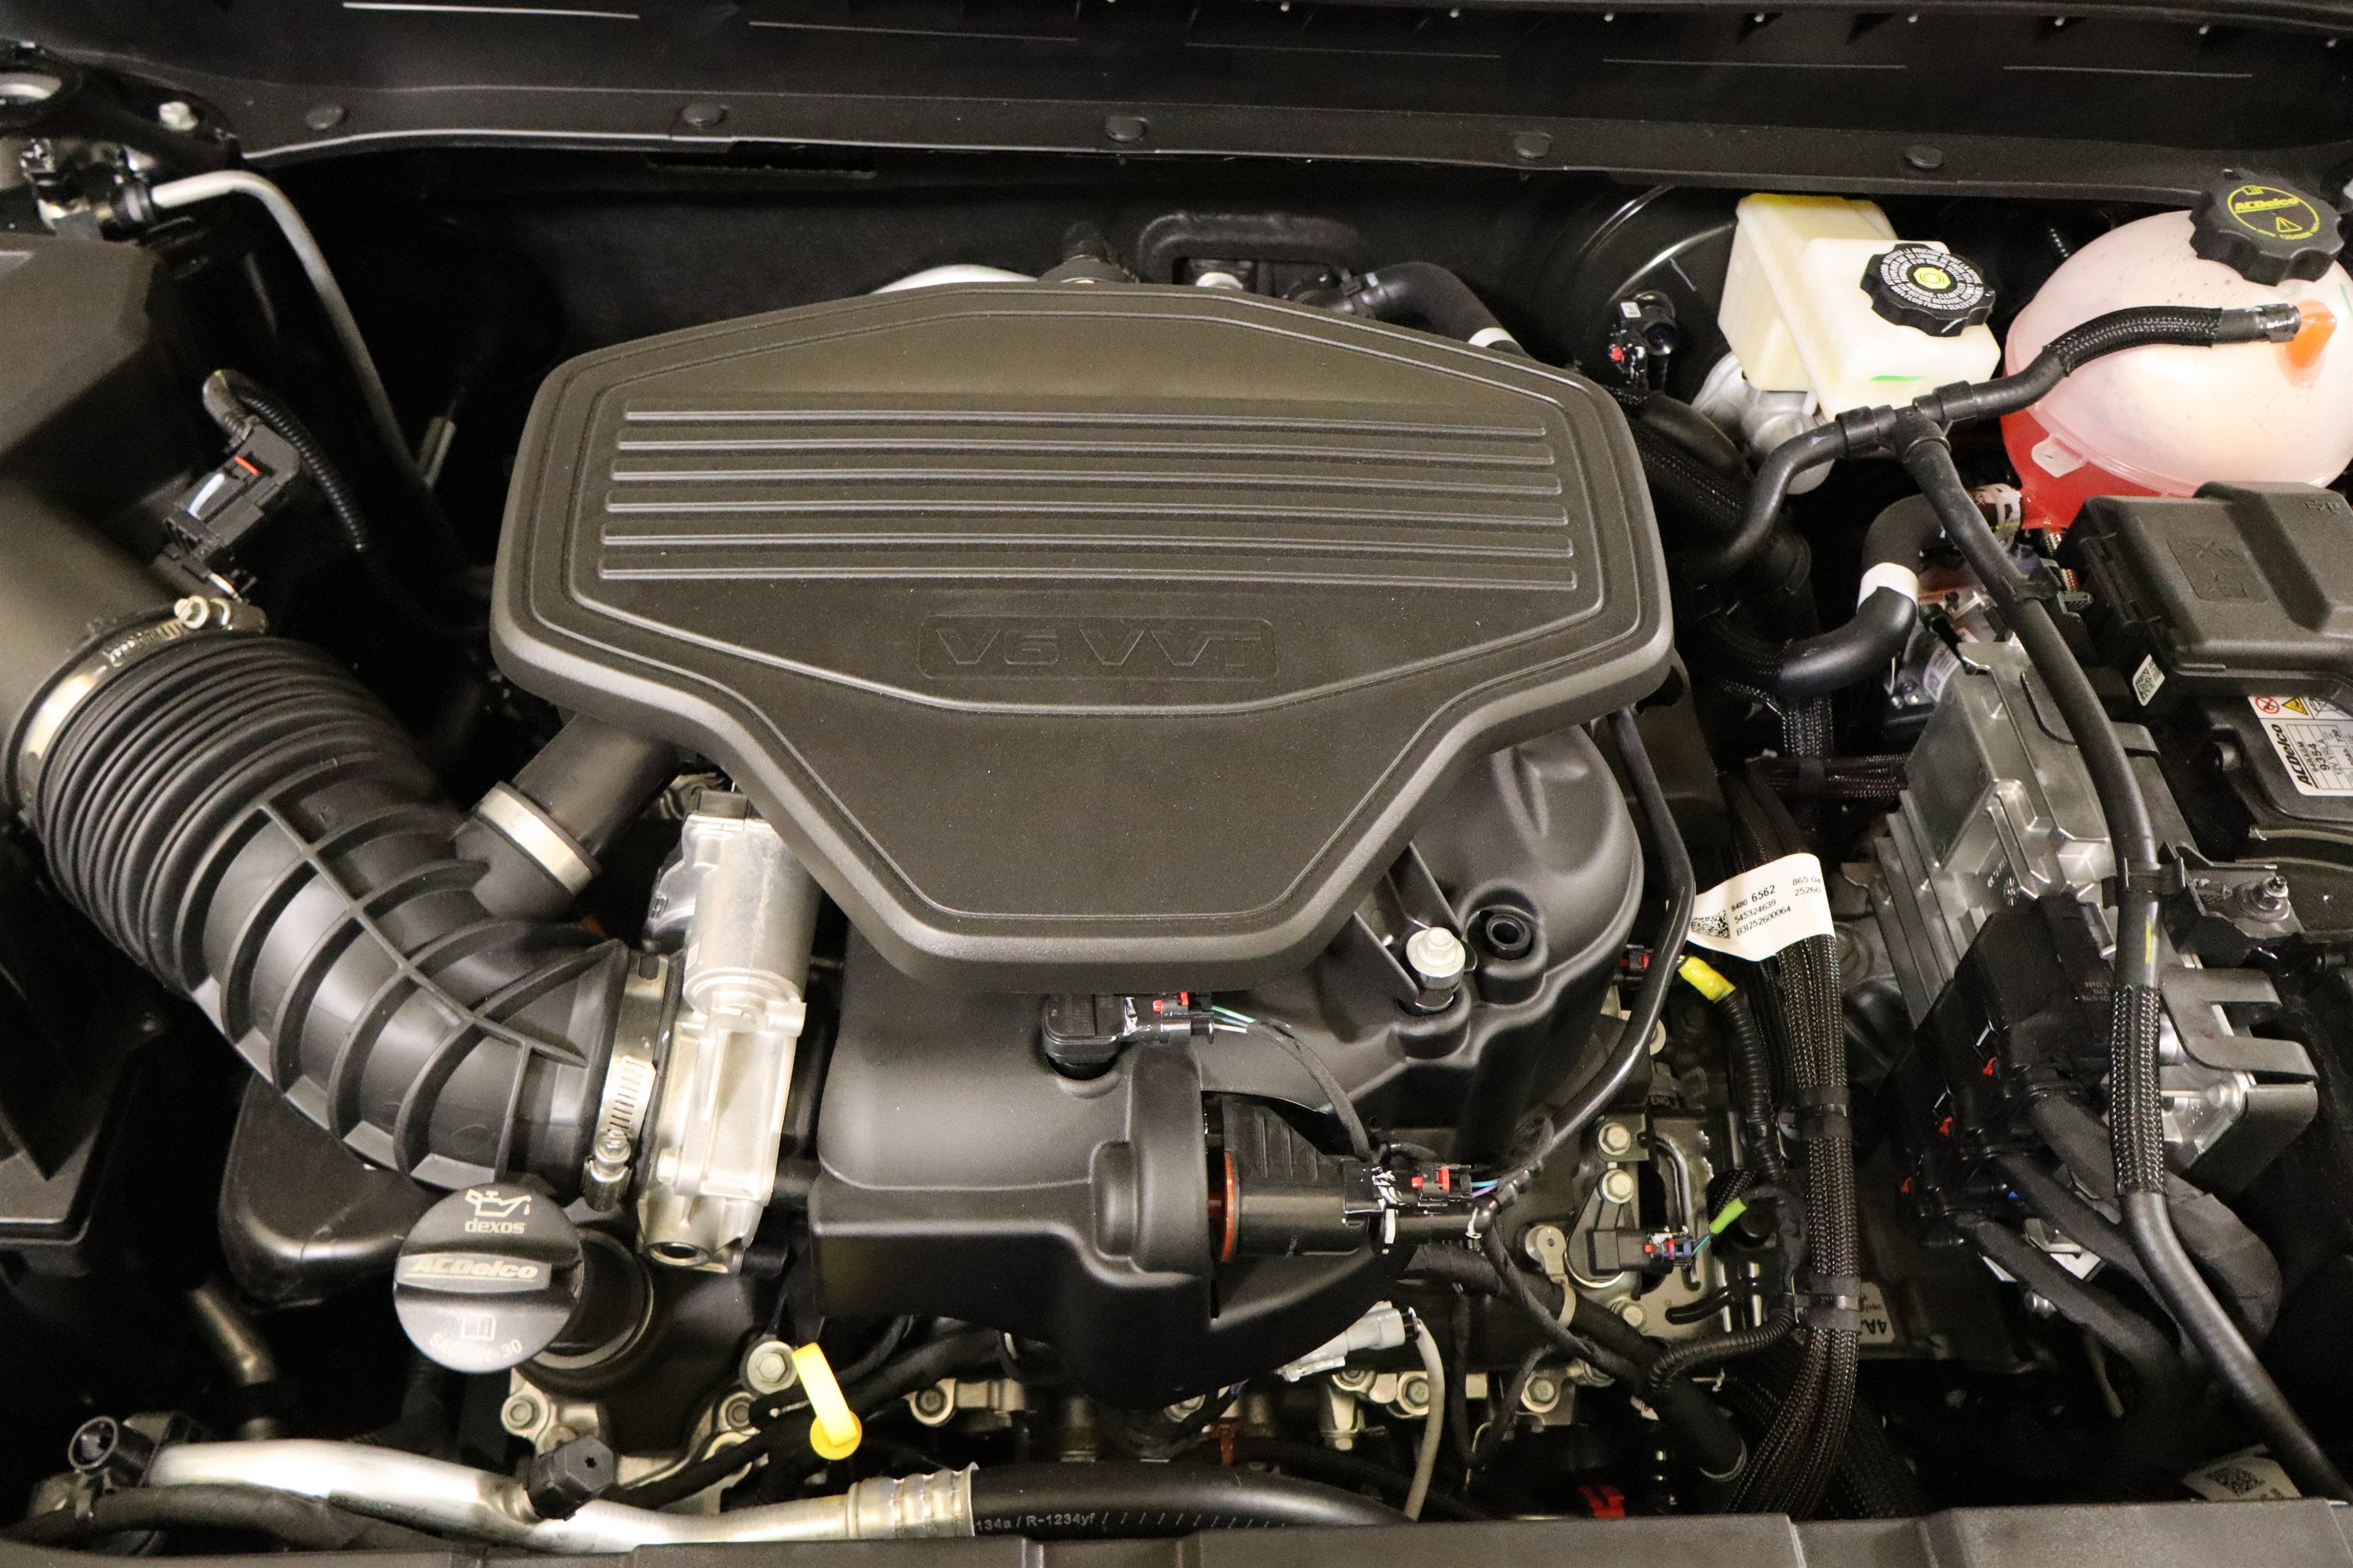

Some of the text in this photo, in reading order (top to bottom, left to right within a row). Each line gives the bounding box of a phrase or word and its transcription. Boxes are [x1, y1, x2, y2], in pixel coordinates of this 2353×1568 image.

[936, 629, 1059, 665] V6
[2271, 724, 2313, 786] ACDelco
[2308, 743, 2329, 771] 9354
[1731, 885, 1776, 912] 8480 6562
[465, 1218, 525, 1234] dexos
[410, 1258, 539, 1279] ACDelco
[1027, 1513, 1096, 1527] R-1234yf
